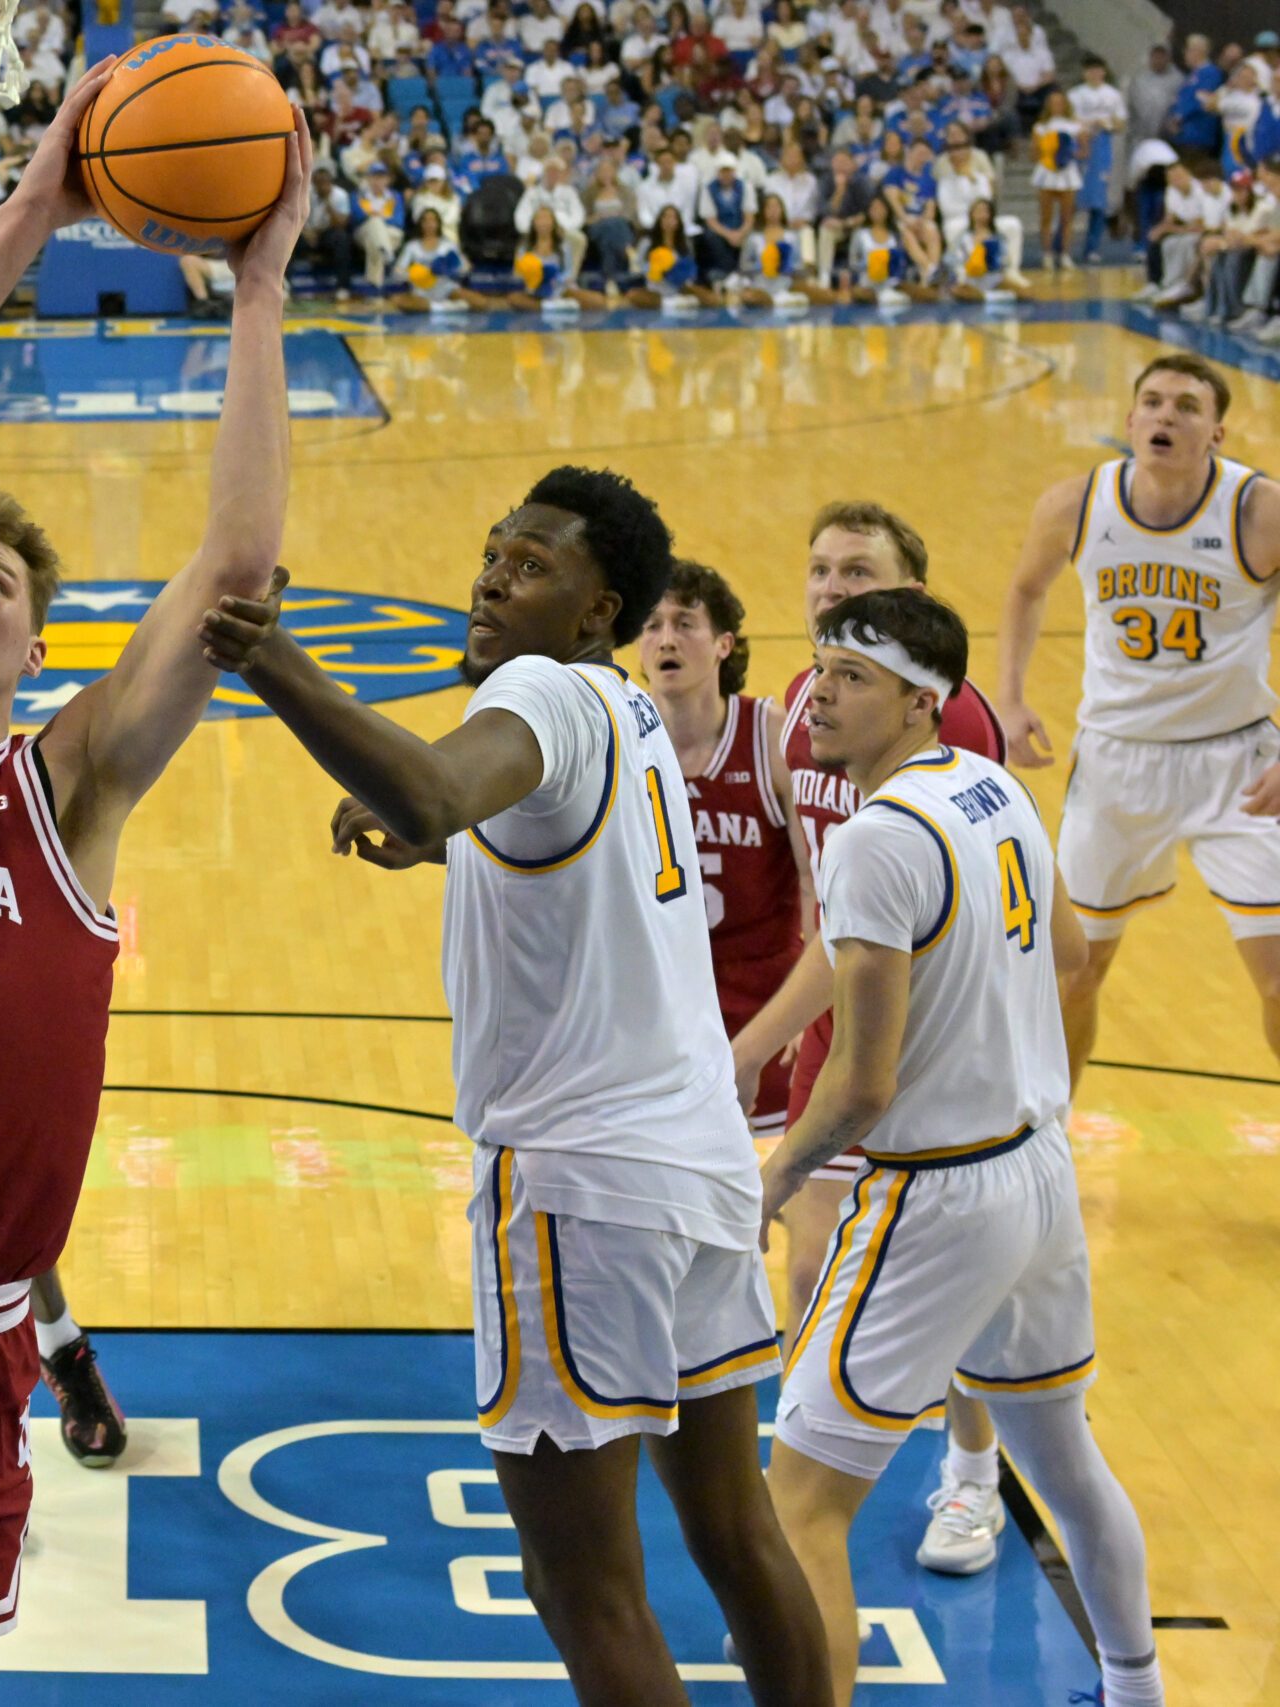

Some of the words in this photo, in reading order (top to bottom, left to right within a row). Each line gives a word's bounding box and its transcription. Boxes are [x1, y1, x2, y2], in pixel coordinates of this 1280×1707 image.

[1097, 562, 1221, 611] BRUINS
[1112, 606, 1207, 661] 34
[792, 768, 864, 818] NDIAN
[645, 765, 687, 904] 1
[996, 836, 1037, 954] 4
